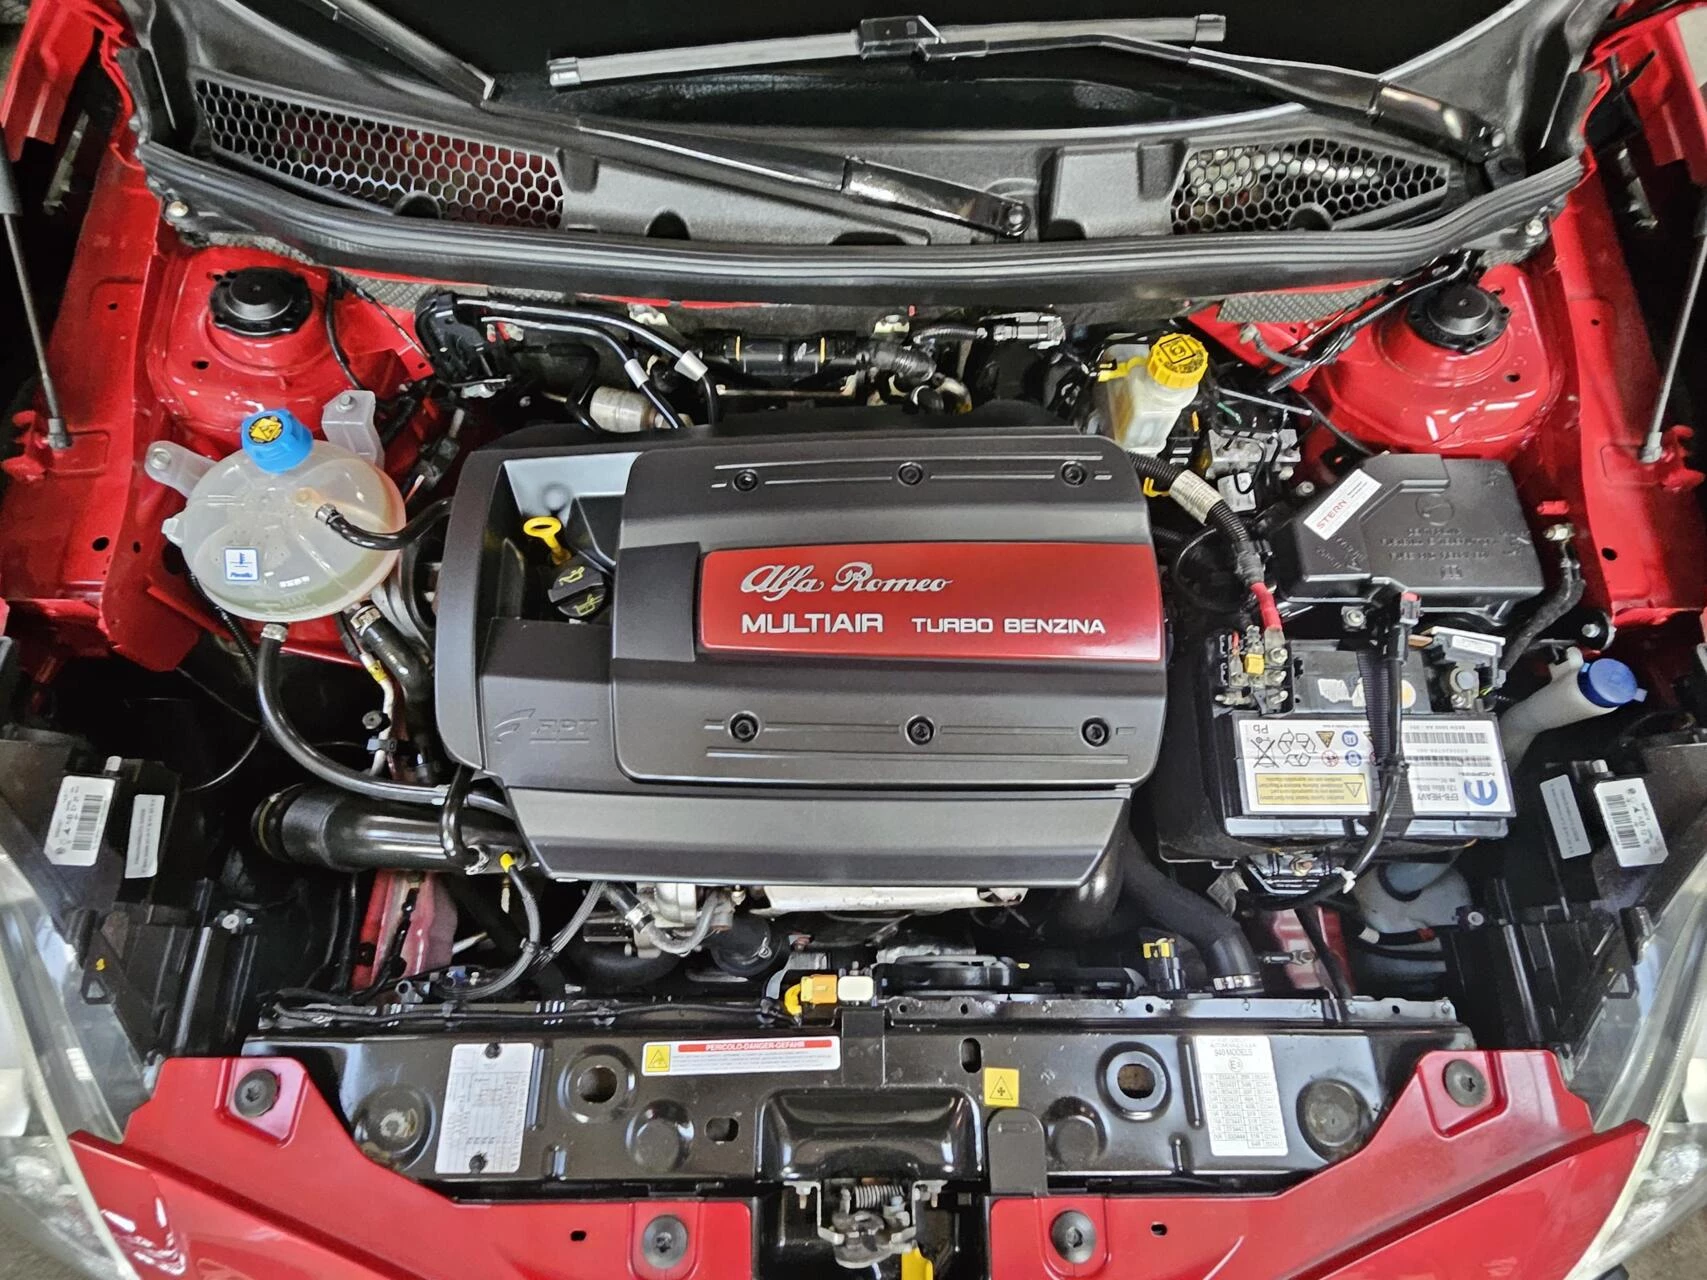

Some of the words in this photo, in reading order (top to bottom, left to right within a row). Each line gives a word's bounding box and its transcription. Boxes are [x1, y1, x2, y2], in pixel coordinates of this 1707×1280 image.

[1316, 499, 1347, 530] STERN
[740, 564, 825, 602] Alfa
[831, 561, 953, 592] Romeo
[741, 613, 883, 633] MULTIAIR
[911, 617, 993, 633] TURBO
[1004, 618, 1106, 634] BENZINA
[1252, 723, 1269, 734] Pb
